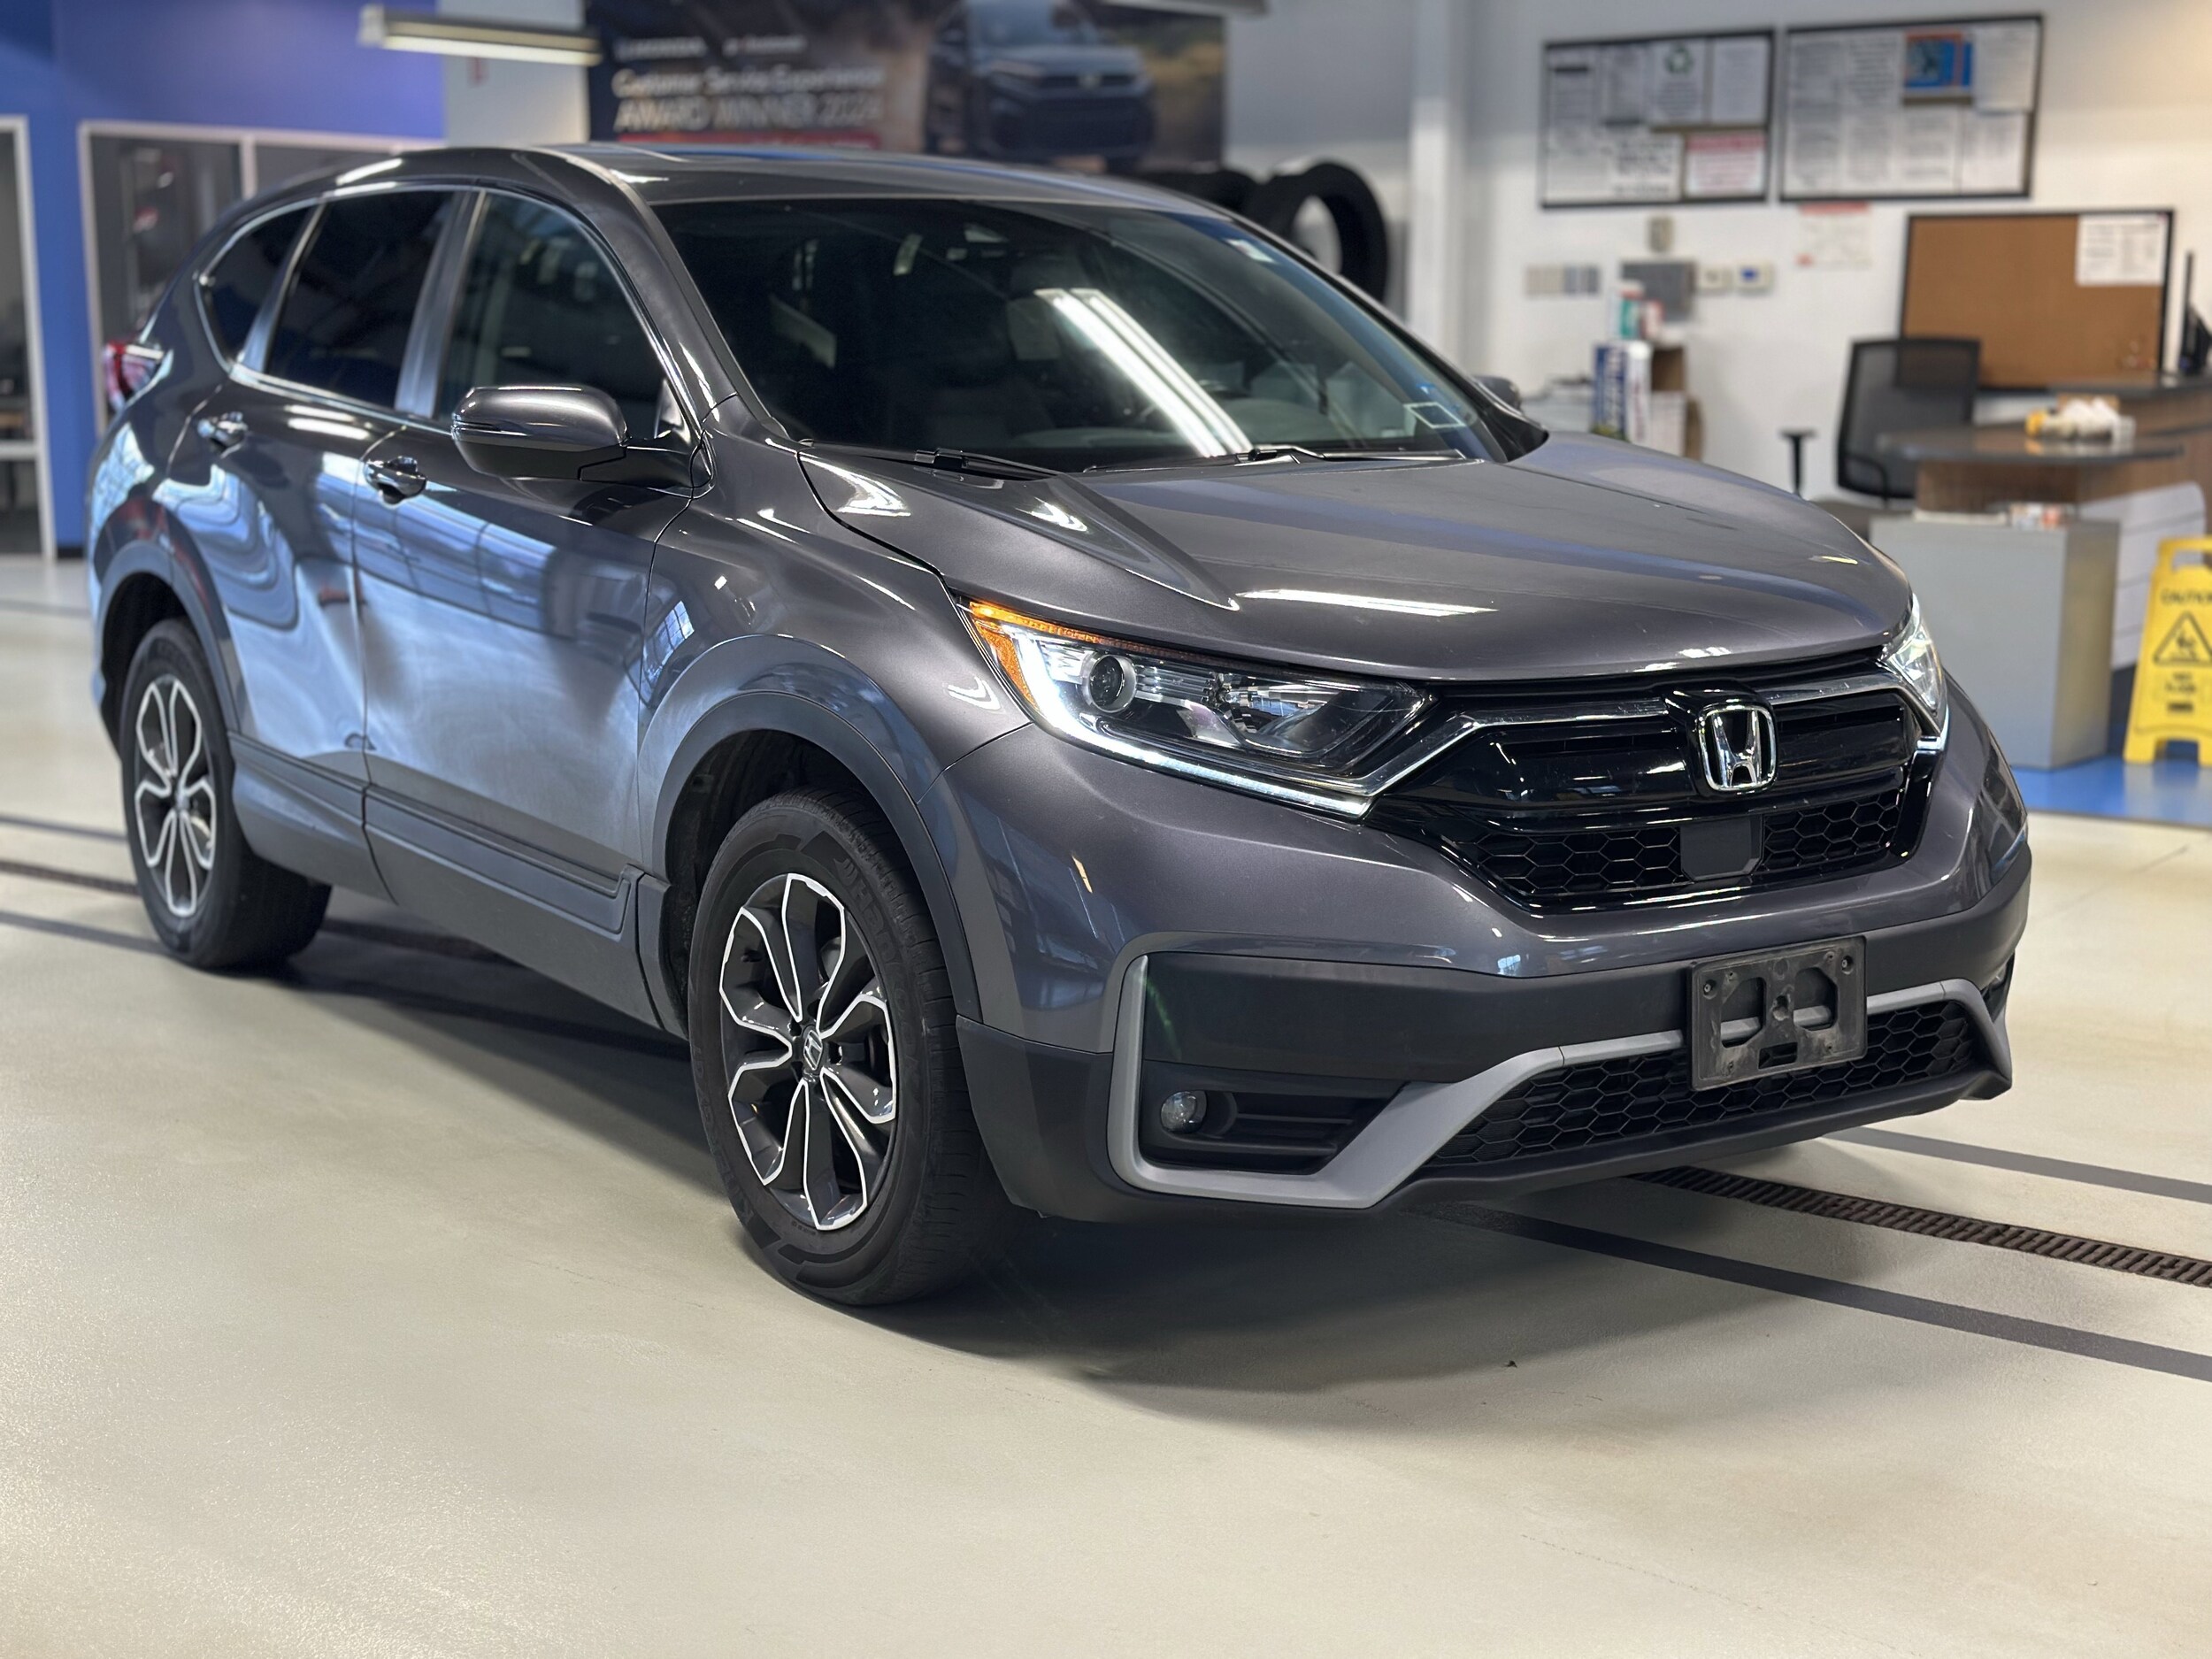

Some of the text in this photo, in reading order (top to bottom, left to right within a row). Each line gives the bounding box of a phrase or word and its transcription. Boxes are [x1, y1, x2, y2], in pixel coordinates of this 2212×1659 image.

[613, 70, 705, 96] Customer
[615, 97, 708, 130] AWARD
[711, 95, 816, 129] WINNER
